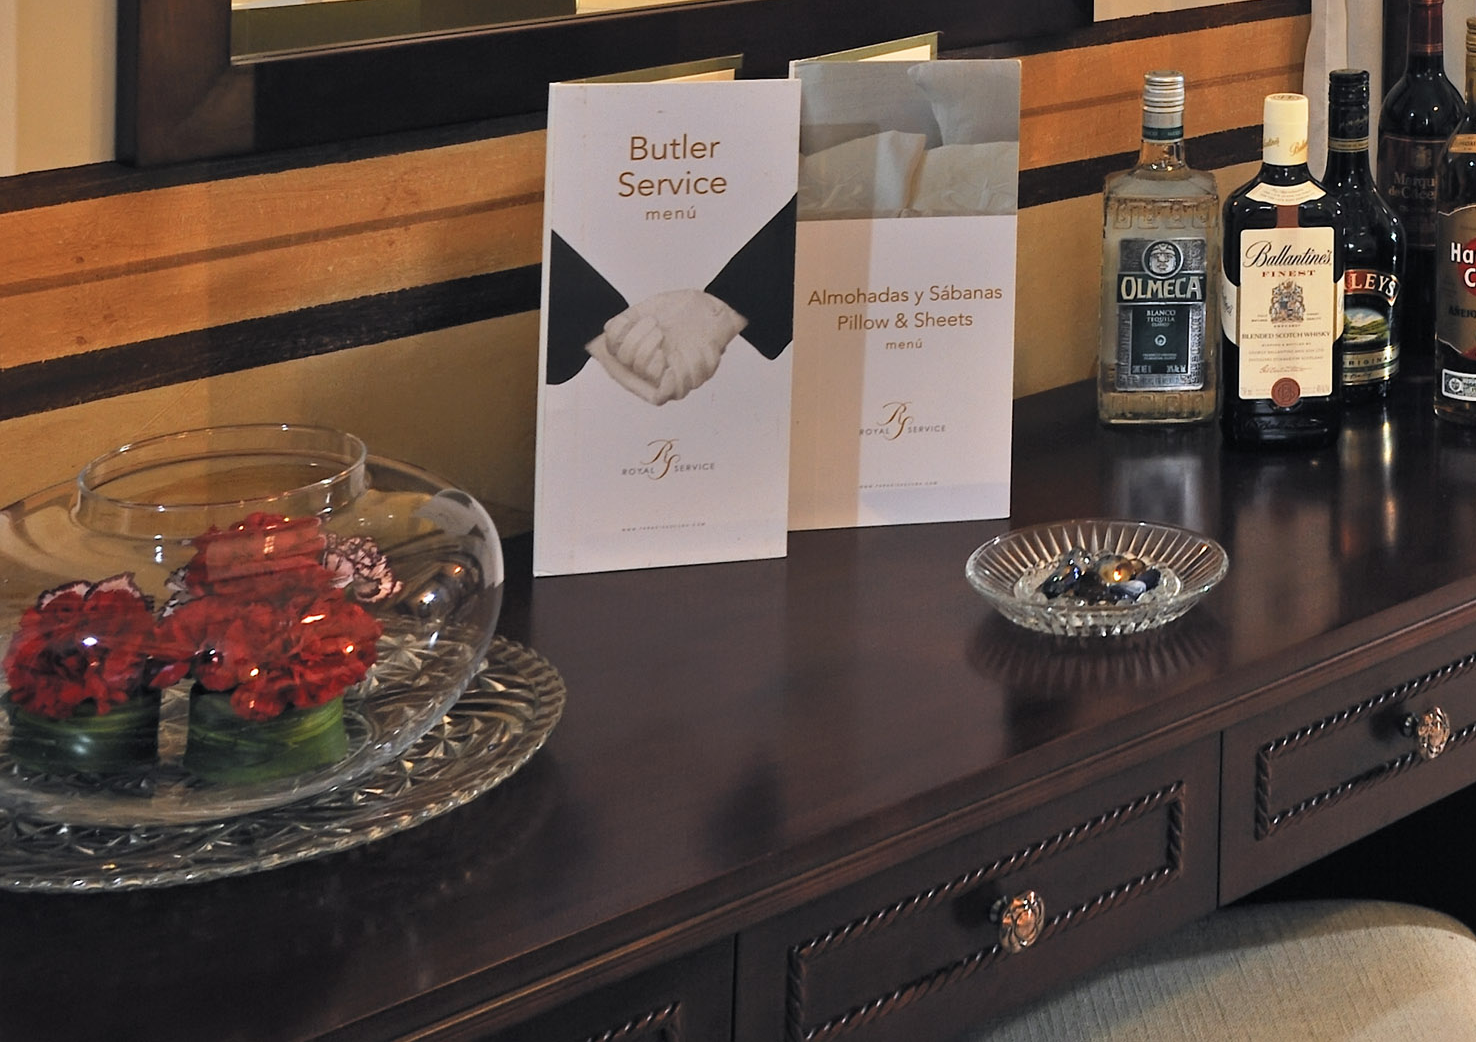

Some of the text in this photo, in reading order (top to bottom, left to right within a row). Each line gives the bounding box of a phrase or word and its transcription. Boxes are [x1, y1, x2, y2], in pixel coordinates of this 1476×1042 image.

[630, 133, 720, 161] Butler
[618, 171, 727, 198] Service
[645, 205, 696, 221] menú
[1243, 240, 1333, 268] Ballantine's
[1261, 269, 1316, 278] FINEST
[1120, 276, 1203, 300] OLMECA
[1345, 272, 1396, 297] LEYS
[808, 284, 1003, 306] Almohadas y Sábanas
[838, 312, 973, 331] Pillow & Sheets
[1146, 309, 1176, 317] BLANCO
[885, 336, 923, 350] menú
[1242, 330, 1330, 340] BLENDED SCOTCH WHISKY
[859, 424, 946, 436] ROYAL SERVICE
[622, 462, 716, 476] ROYAL SERVICE
